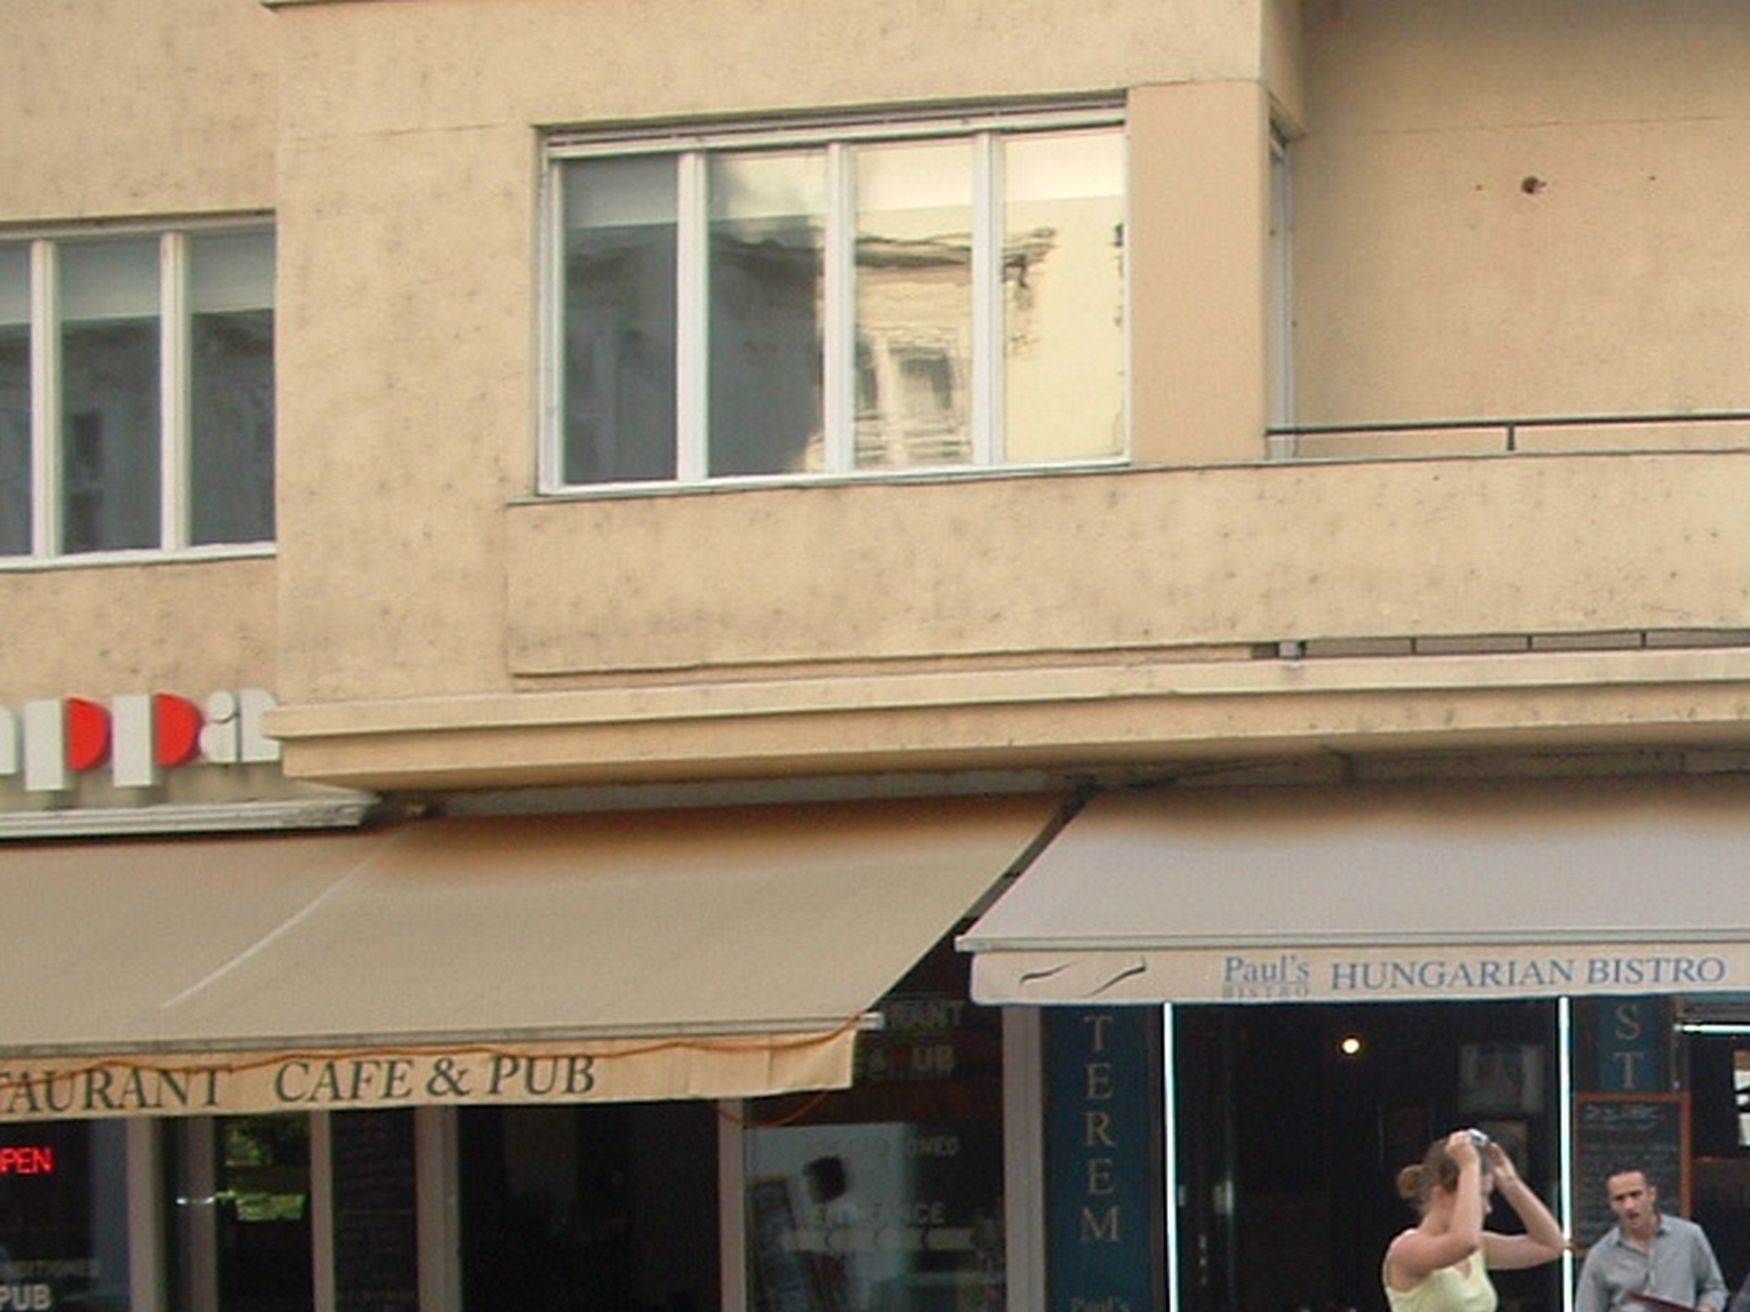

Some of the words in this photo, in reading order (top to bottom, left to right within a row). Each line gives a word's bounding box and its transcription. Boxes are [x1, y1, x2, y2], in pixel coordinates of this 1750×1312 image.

[0, 688, 282, 791] ppa
[1224, 955, 1310, 983] Paul's
[1330, 958, 1575, 991] HUNGARIAN
[1586, 956, 1726, 985] BISTRO
[0, 1063, 232, 1114] AURANT
[273, 1058, 415, 1102] CAFE
[425, 1056, 470, 1098] &
[484, 1053, 596, 1096] PUB
[1079, 1014, 1123, 1243] TEREM
